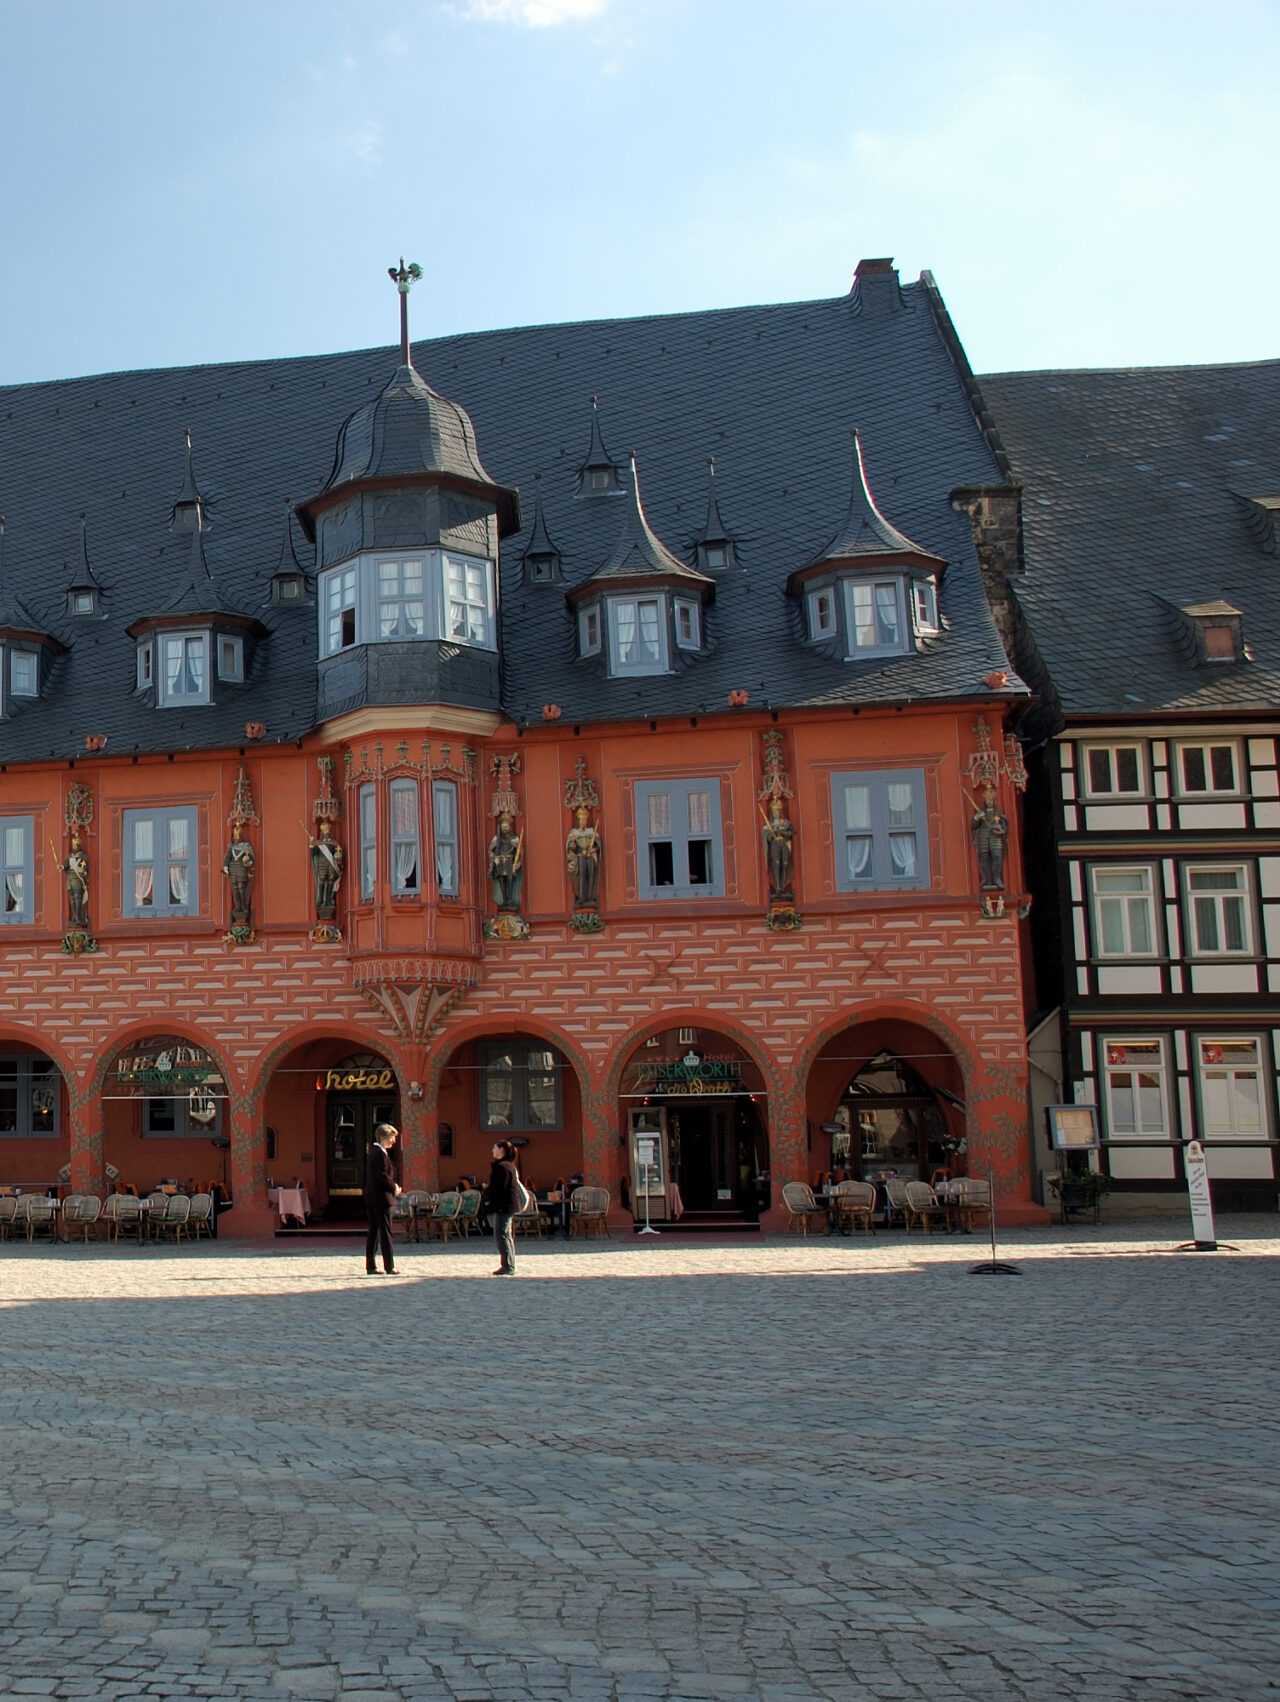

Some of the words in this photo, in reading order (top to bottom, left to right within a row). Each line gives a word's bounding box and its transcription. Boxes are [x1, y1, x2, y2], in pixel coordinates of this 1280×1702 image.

[703, 1053, 735, 1062] Hotel
[325, 1070, 394, 1090] hotel
[637, 1062, 741, 1080] KAISERWORTH
